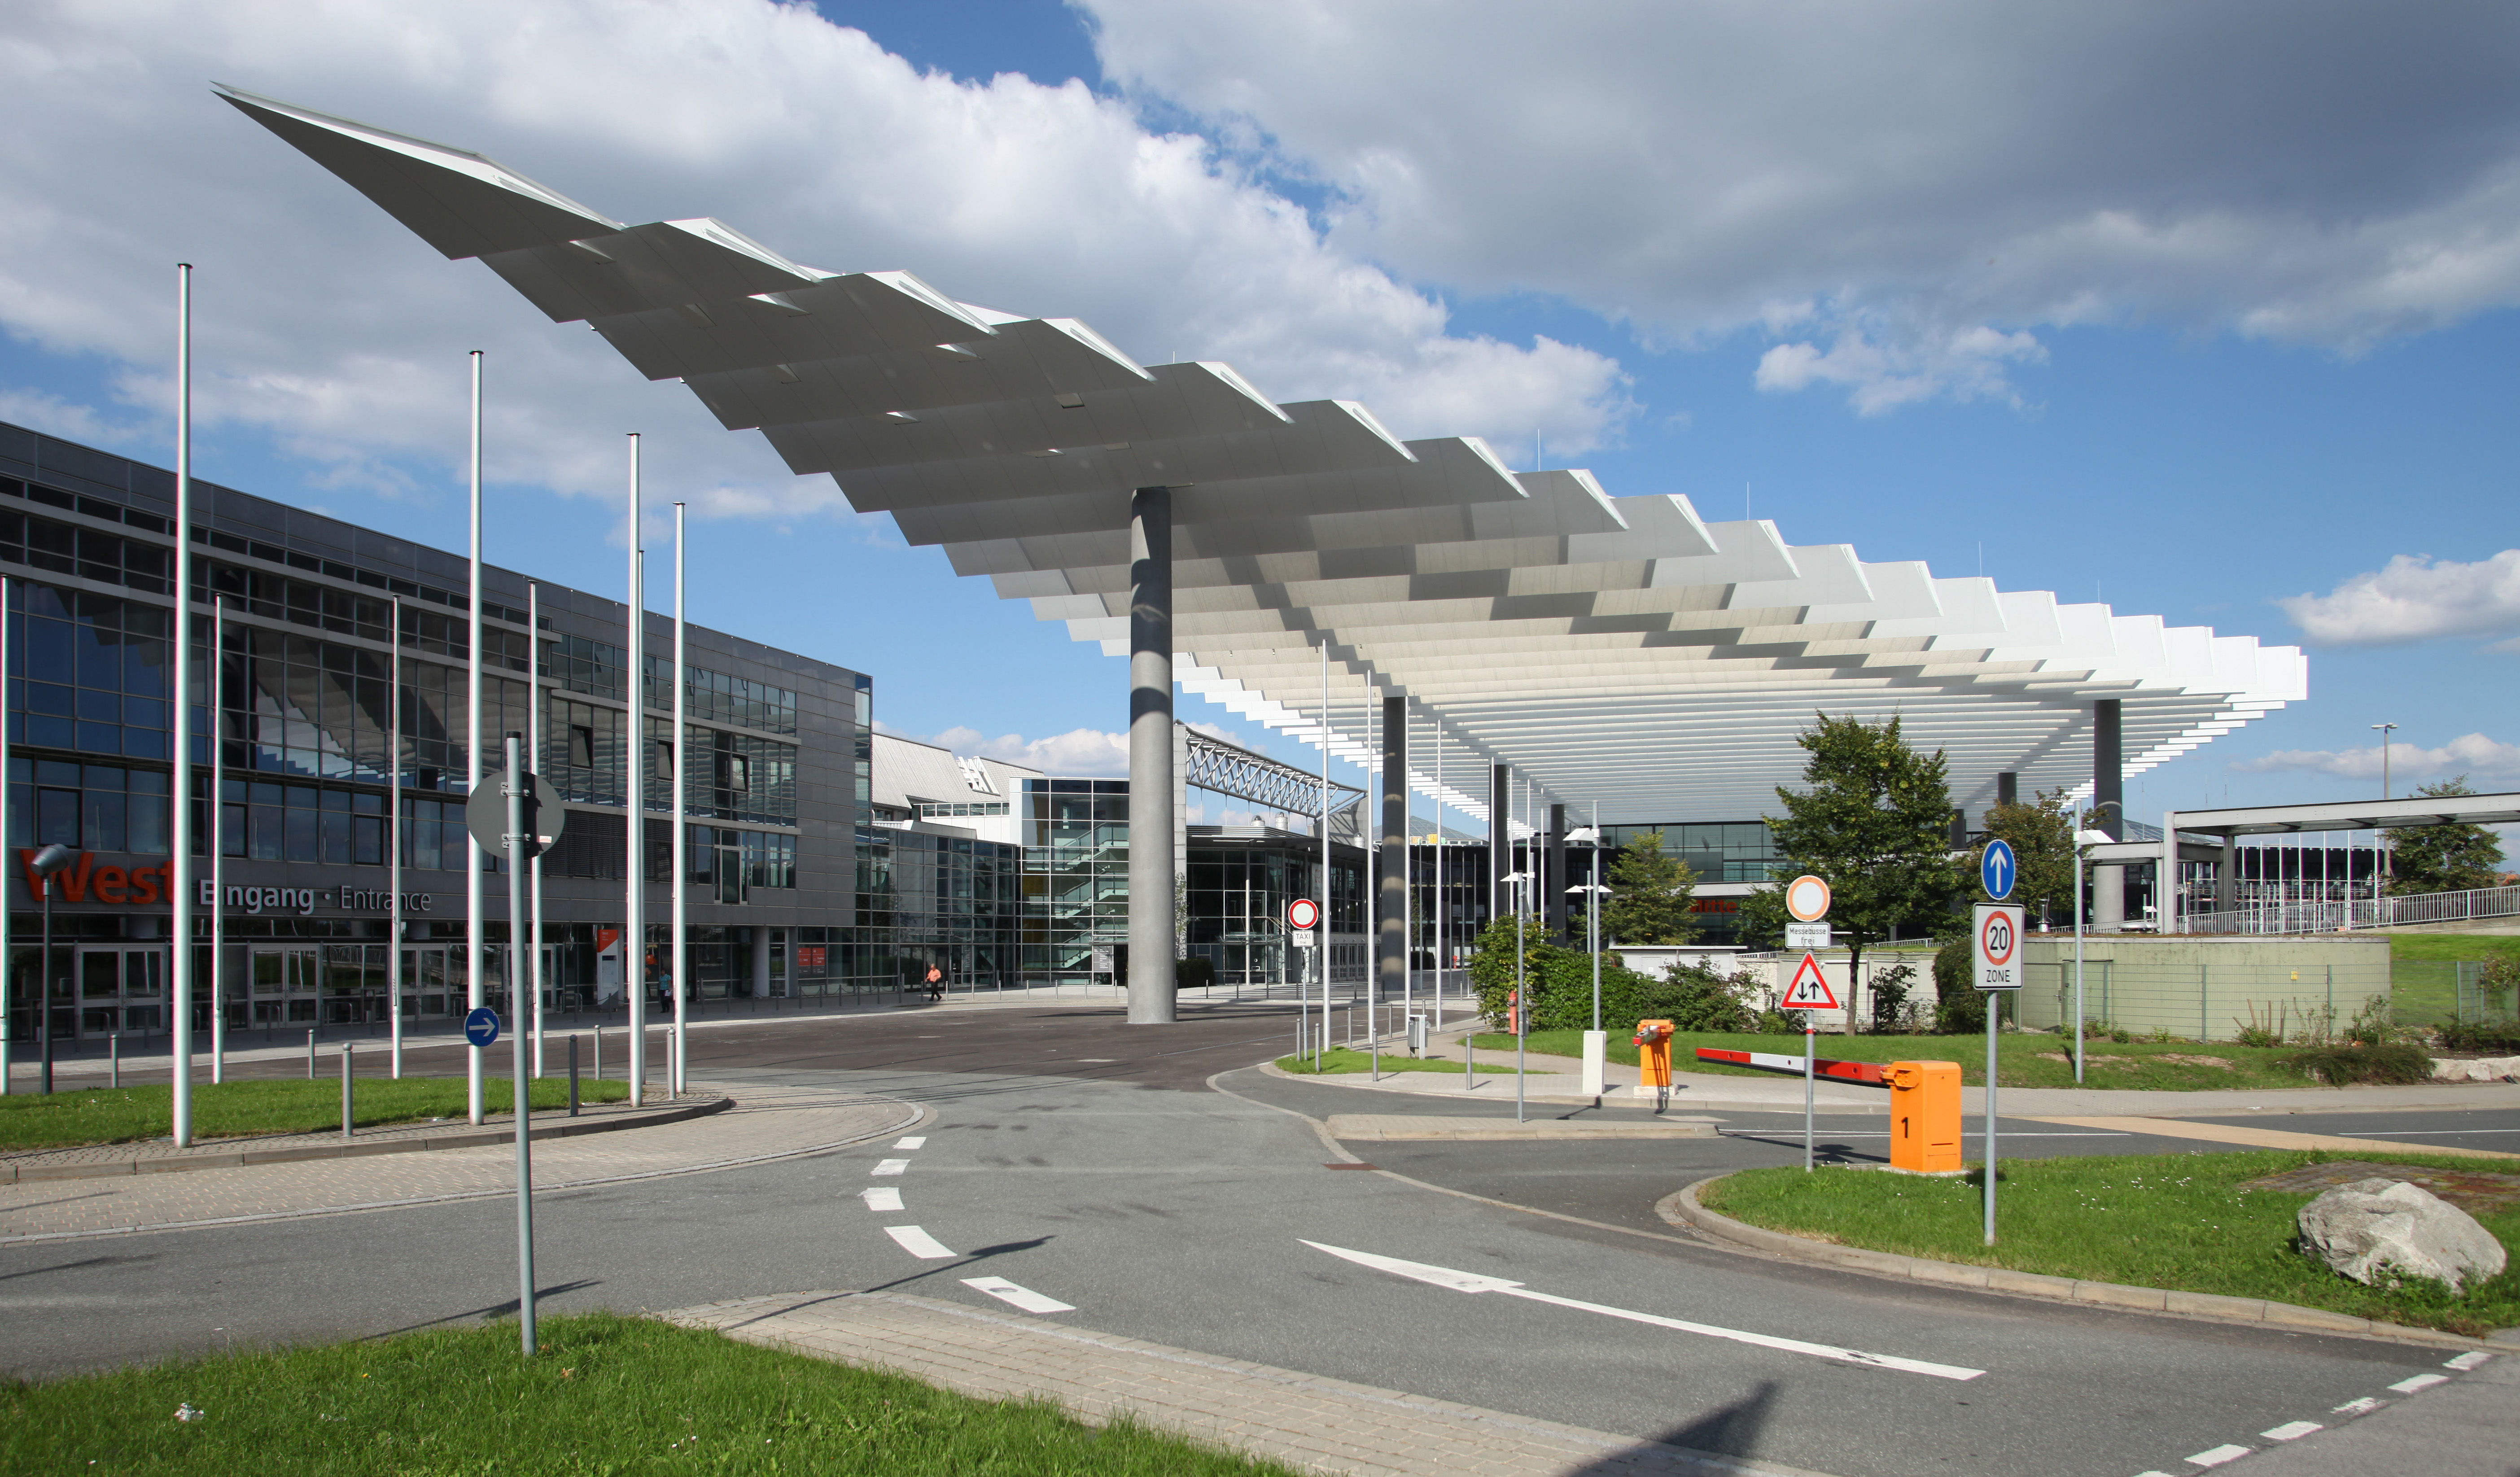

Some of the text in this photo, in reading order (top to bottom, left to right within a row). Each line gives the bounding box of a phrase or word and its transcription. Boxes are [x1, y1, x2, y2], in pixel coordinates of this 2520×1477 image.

[20, 849, 173, 904] West
[199, 879, 314, 915] Engang
[341, 885, 431, 911] Entrance
[1990, 926, 2008, 950] 20
[1986, 970, 2010, 983] ZONE
[1901, 1116, 1908, 1138] 1
